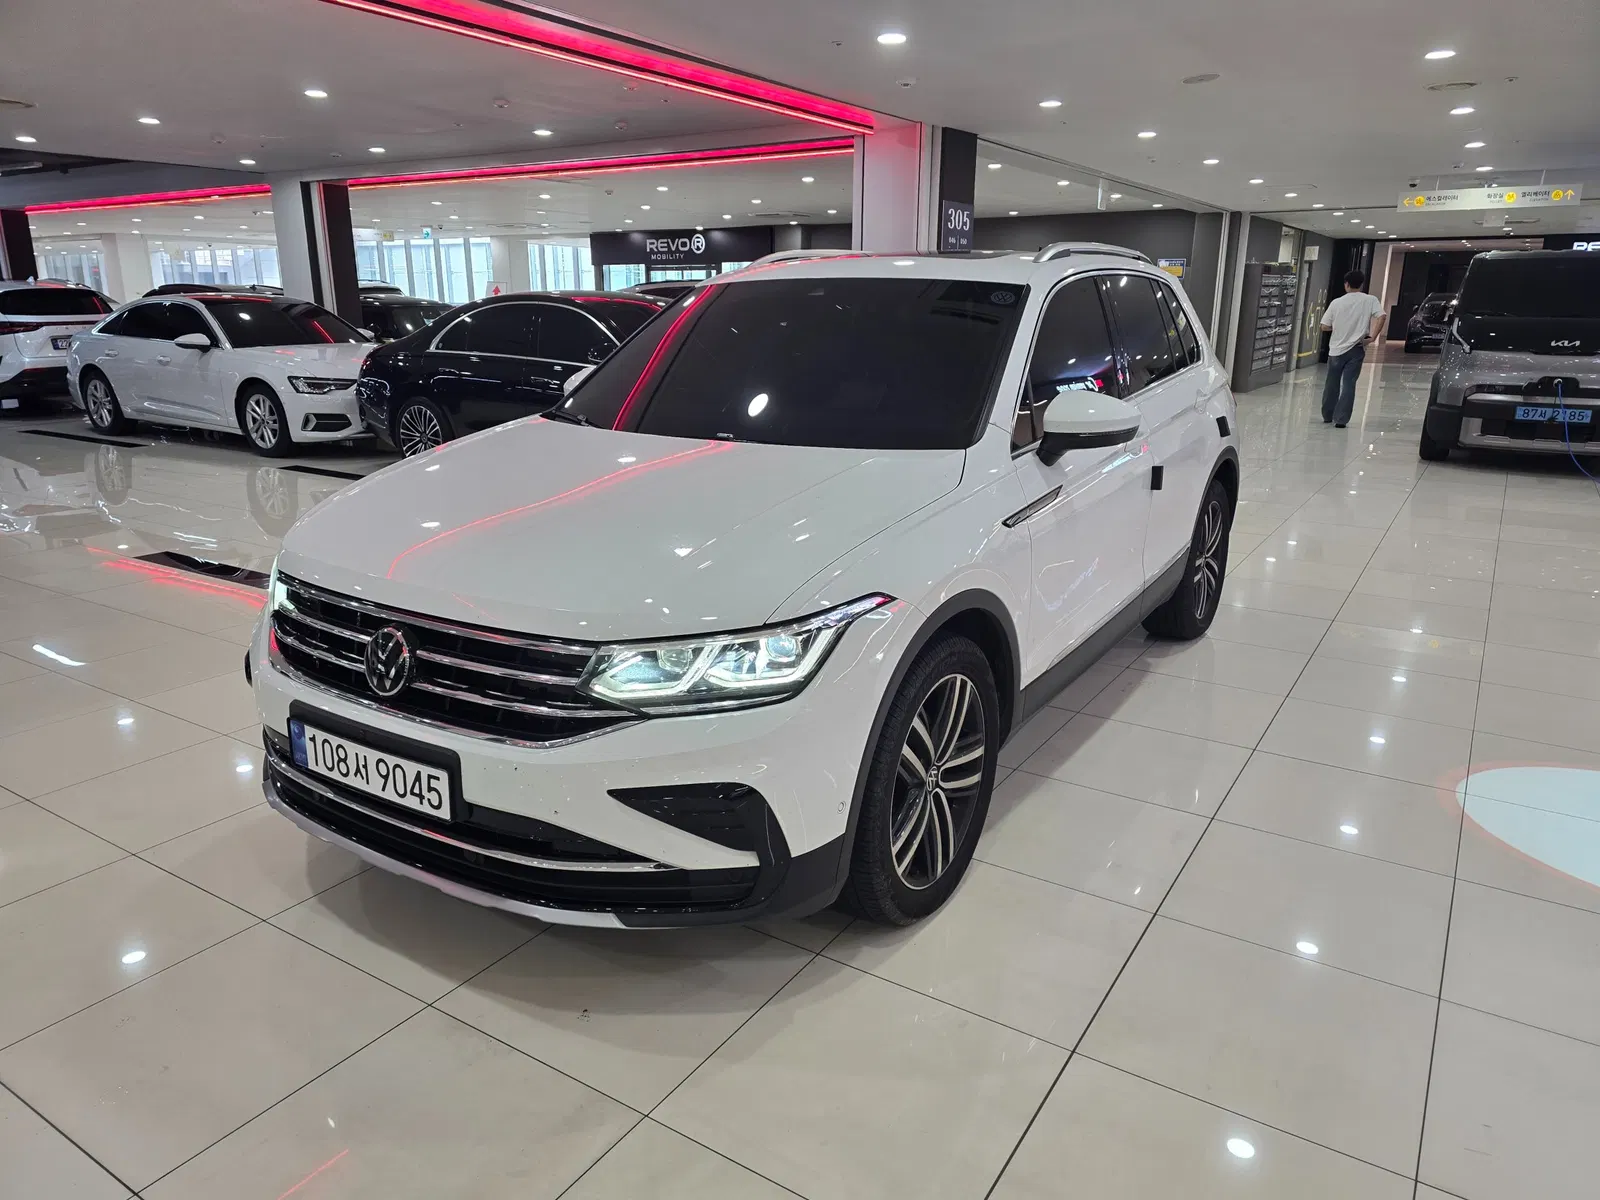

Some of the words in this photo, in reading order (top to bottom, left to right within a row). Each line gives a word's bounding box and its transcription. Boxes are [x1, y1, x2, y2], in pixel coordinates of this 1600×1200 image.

[948, 208, 970, 231] 305
[1550, 339, 1581, 347] KIA
[1522, 408, 1546, 419] 87서
[308, 734, 370, 785] 108서
[375, 758, 443, 810] 9045
